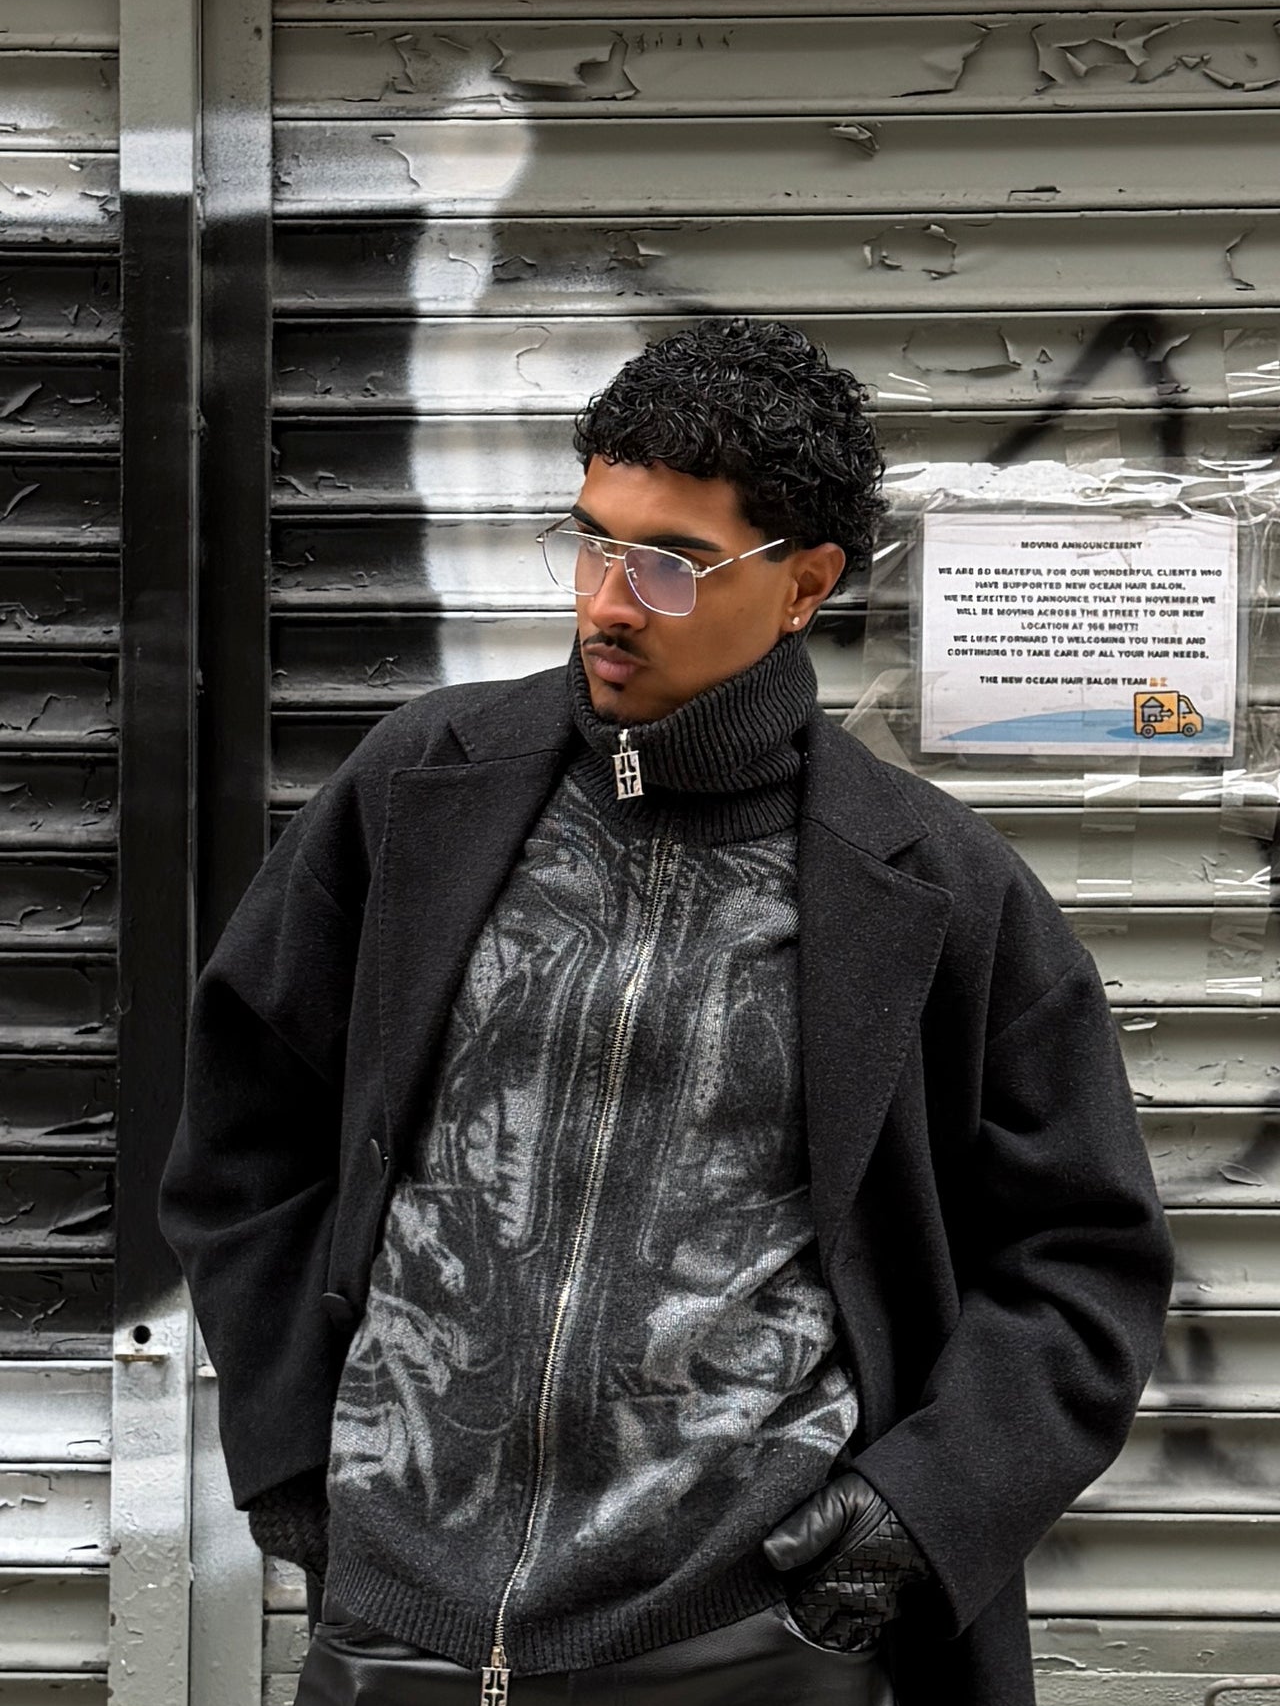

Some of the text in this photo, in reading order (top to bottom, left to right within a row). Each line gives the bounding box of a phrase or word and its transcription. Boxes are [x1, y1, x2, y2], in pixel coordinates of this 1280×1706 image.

[1020, 540, 1143, 550] MOVING ANNOUNCEMENT
[937, 566, 953, 576] WE
[977, 567, 992, 576] SO
[993, 567, 1044, 577] GRATEFUL
[1046, 568, 1067, 577] FOR
[1069, 568, 1091, 577] OUR
[1092, 568, 1154, 577] WONDERFUL
[1156, 568, 1198, 577] CLIENTS
[1199, 568, 1223, 578] WHO
[1002, 581, 1063, 590] SUPPORTED
[1064, 581, 1087, 590] NEW
[1088, 581, 1123, 591] OCEAN
[1124, 581, 1148, 591] HAIR
[1150, 581, 1187, 591] SALON.
[1020, 594, 1034, 604] TO
[1035, 594, 1090, 604] ANNOUNCE
[1092, 594, 1118, 604] THAT
[1119, 595, 1143, 604] THIS
[1144, 595, 1200, 605] NOVEMBER
[1200, 595, 1216, 605] WE
[955, 607, 978, 616] WILL
[996, 608, 1035, 617] MOVING
[1036, 608, 1078, 618] ACROSS
[1079, 608, 1100, 618] THE
[1101, 608, 1140, 618] STREET
[1142, 608, 1157, 618] TO
[1158, 609, 1180, 618] OUR
[1182, 609, 1205, 618] NEW
[1020, 621, 1070, 631] LOCATION
[1071, 621, 1084, 631] AT
[952, 634, 969, 643] WE
[999, 635, 1049, 644] FORWARD
[1051, 635, 1065, 645] TO
[1066, 635, 1126, 645] WELCOMING
[1128, 636, 1149, 645] YOU
[1151, 636, 1184, 646] THERE
[1185, 636, 1207, 646] AND
[1009, 648, 1024, 657] TO
[1026, 648, 1051, 658] TAKE
[1053, 649, 1080, 658] CARE
[1081, 649, 1096, 658] OF
[1097, 649, 1116, 659] ALL
[1116, 649, 1145, 659] YOUR
[1146, 649, 1171, 659] HAIR
[979, 675, 1148, 686] THE NEW OCEAN HAIR SALON TEAM
